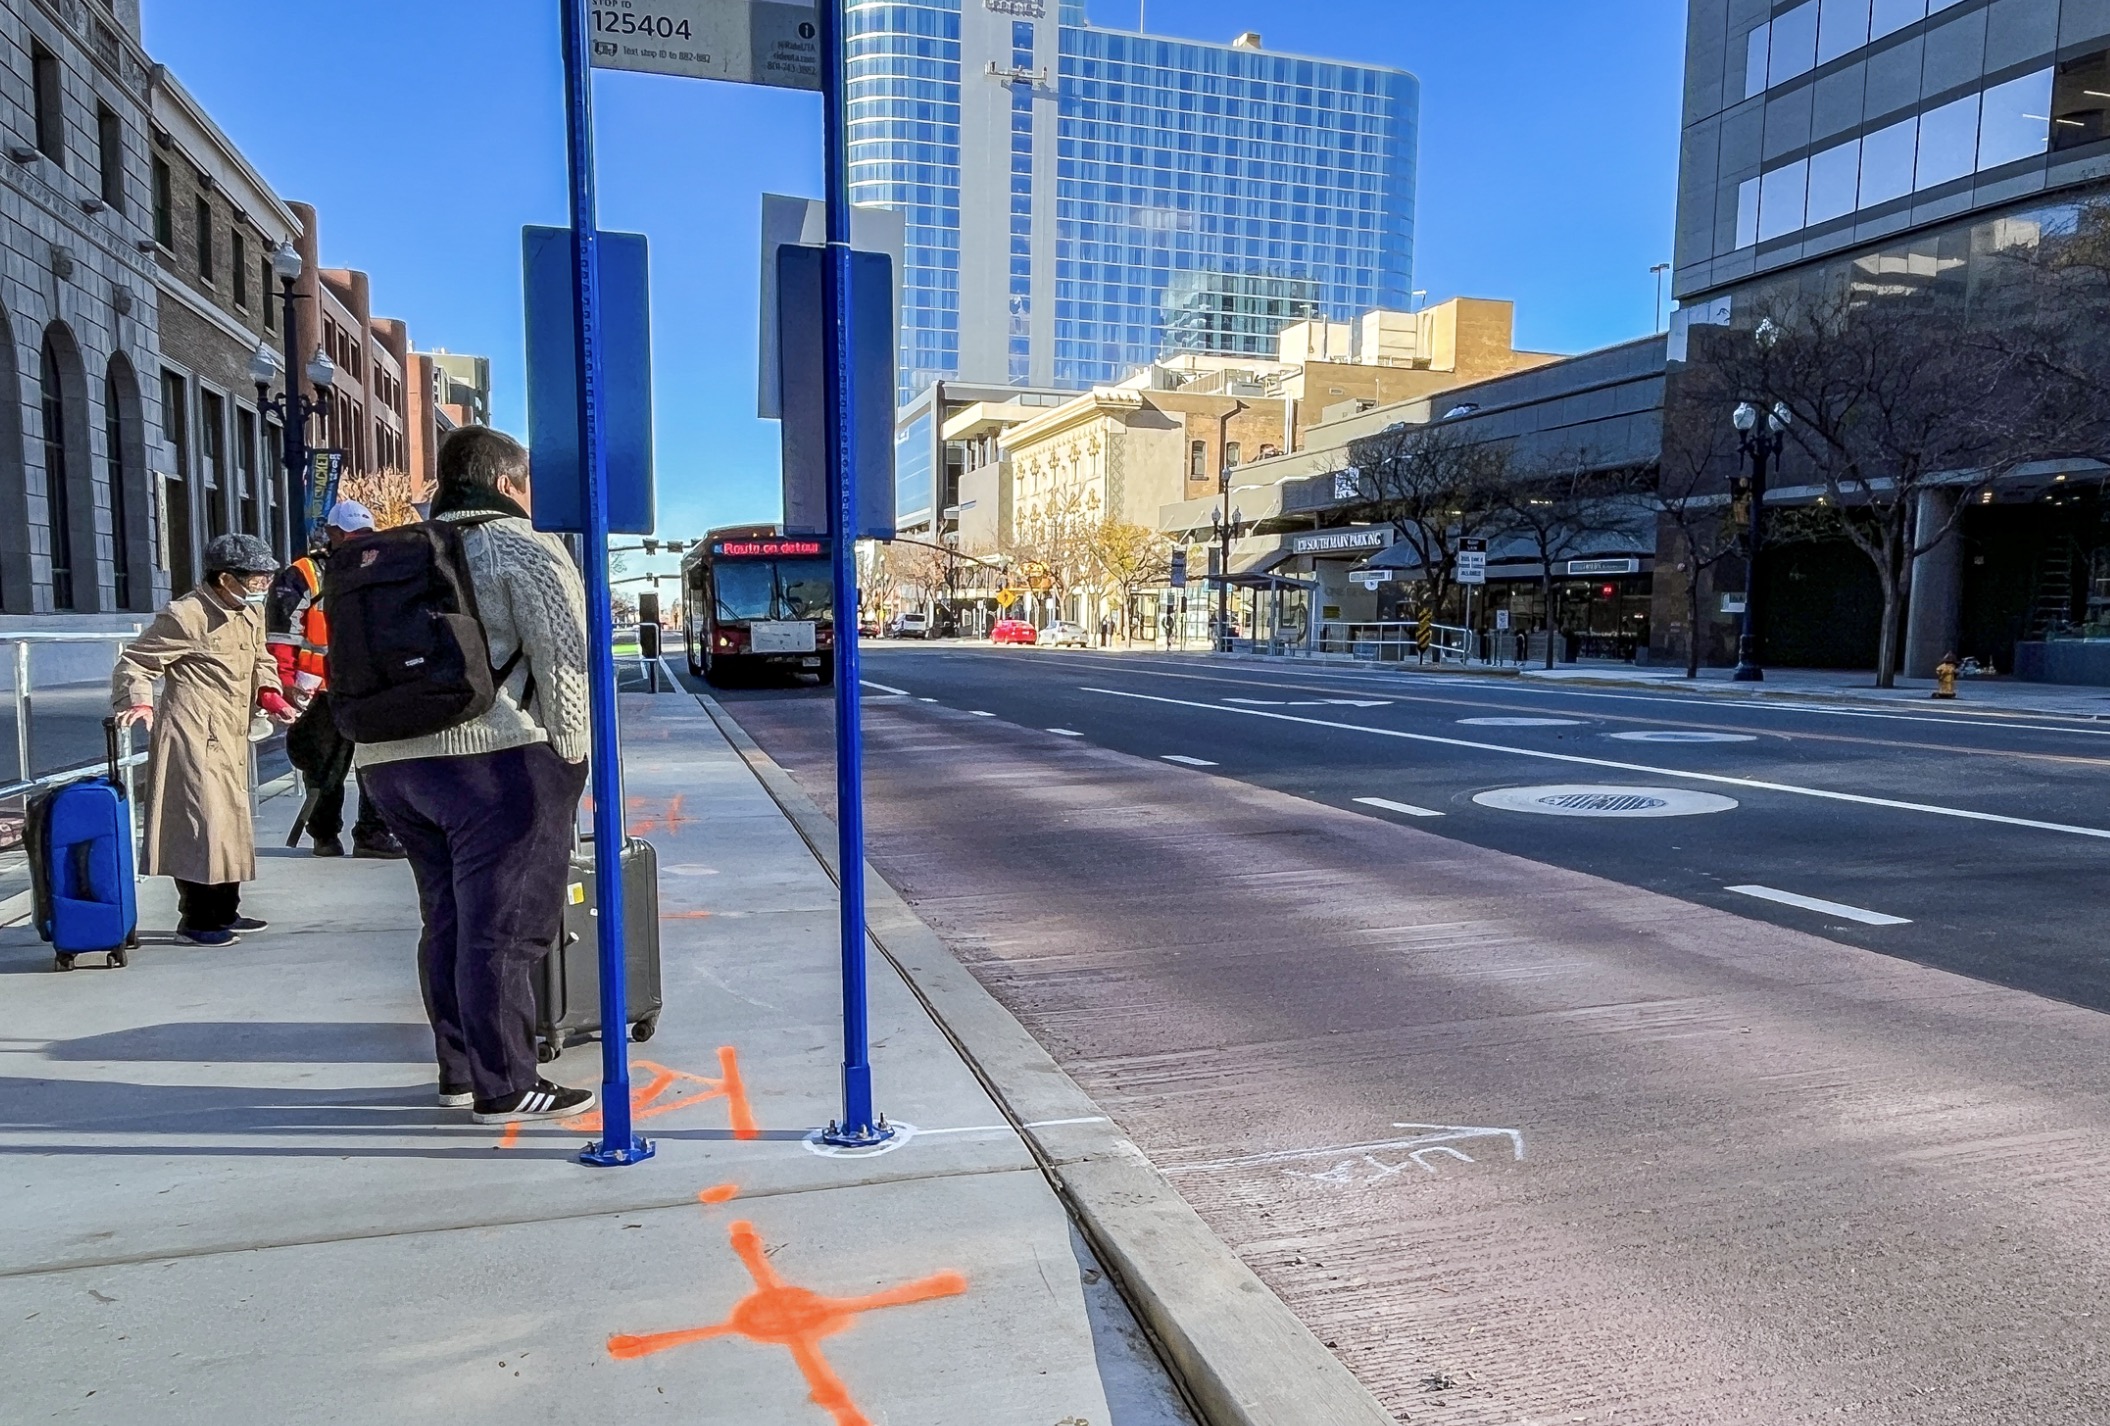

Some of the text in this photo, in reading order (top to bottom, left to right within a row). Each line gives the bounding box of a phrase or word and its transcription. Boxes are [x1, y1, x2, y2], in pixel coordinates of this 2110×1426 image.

[621, 1, 632, 9] ID
[591, 10, 692, 40] 125404
[623, 45, 639, 57] Text
[641, 48, 657, 59] stop
[659, 49, 667, 59] ID
[669, 51, 677, 60] to
[724, 542, 820, 554] Route on detour
[1308, 537, 1329, 551] SOUTH
[1330, 535, 1348, 549] MAIN
[1350, 531, 1382, 547] PARKING
